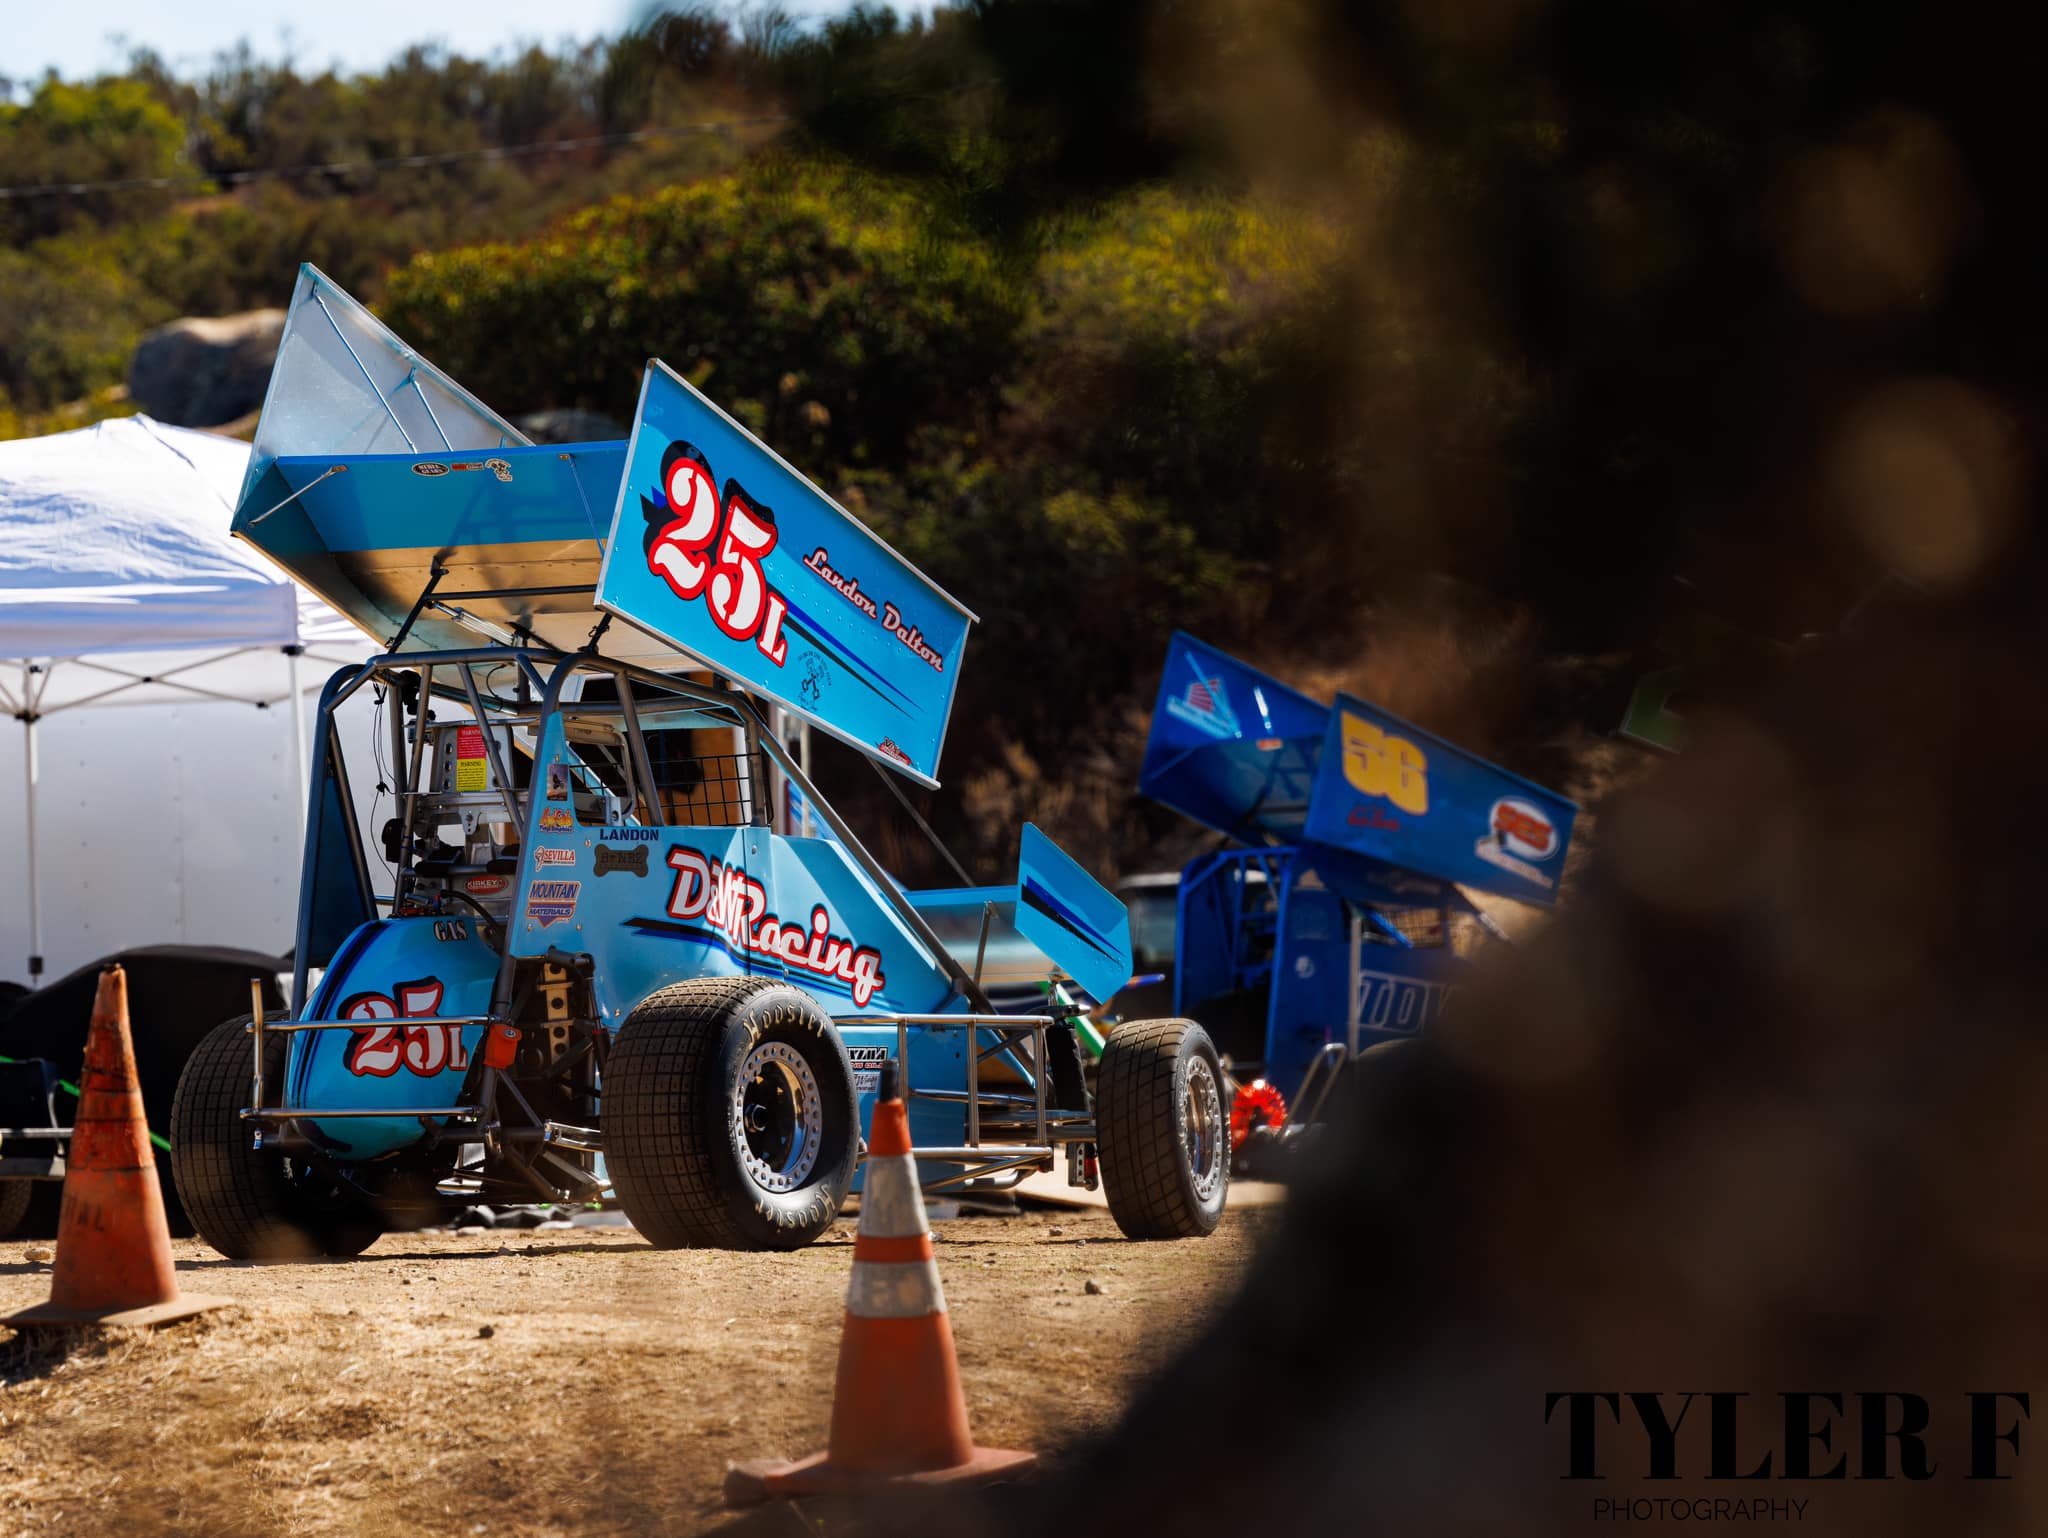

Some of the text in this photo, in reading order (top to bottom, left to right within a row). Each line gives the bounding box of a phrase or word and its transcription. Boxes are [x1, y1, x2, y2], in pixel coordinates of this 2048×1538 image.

[803, 547, 943, 672] Landon Dalton
[600, 828, 659, 841] LANDON
[543, 850, 576, 861] SEVILLA
[466, 879, 497, 888] KIRKEY
[530, 883, 578, 899] MOUNTAIN
[528, 907, 571, 916] MATERIALS
[433, 920, 468, 942] GAS
[743, 1002, 828, 1047] Hoosier
